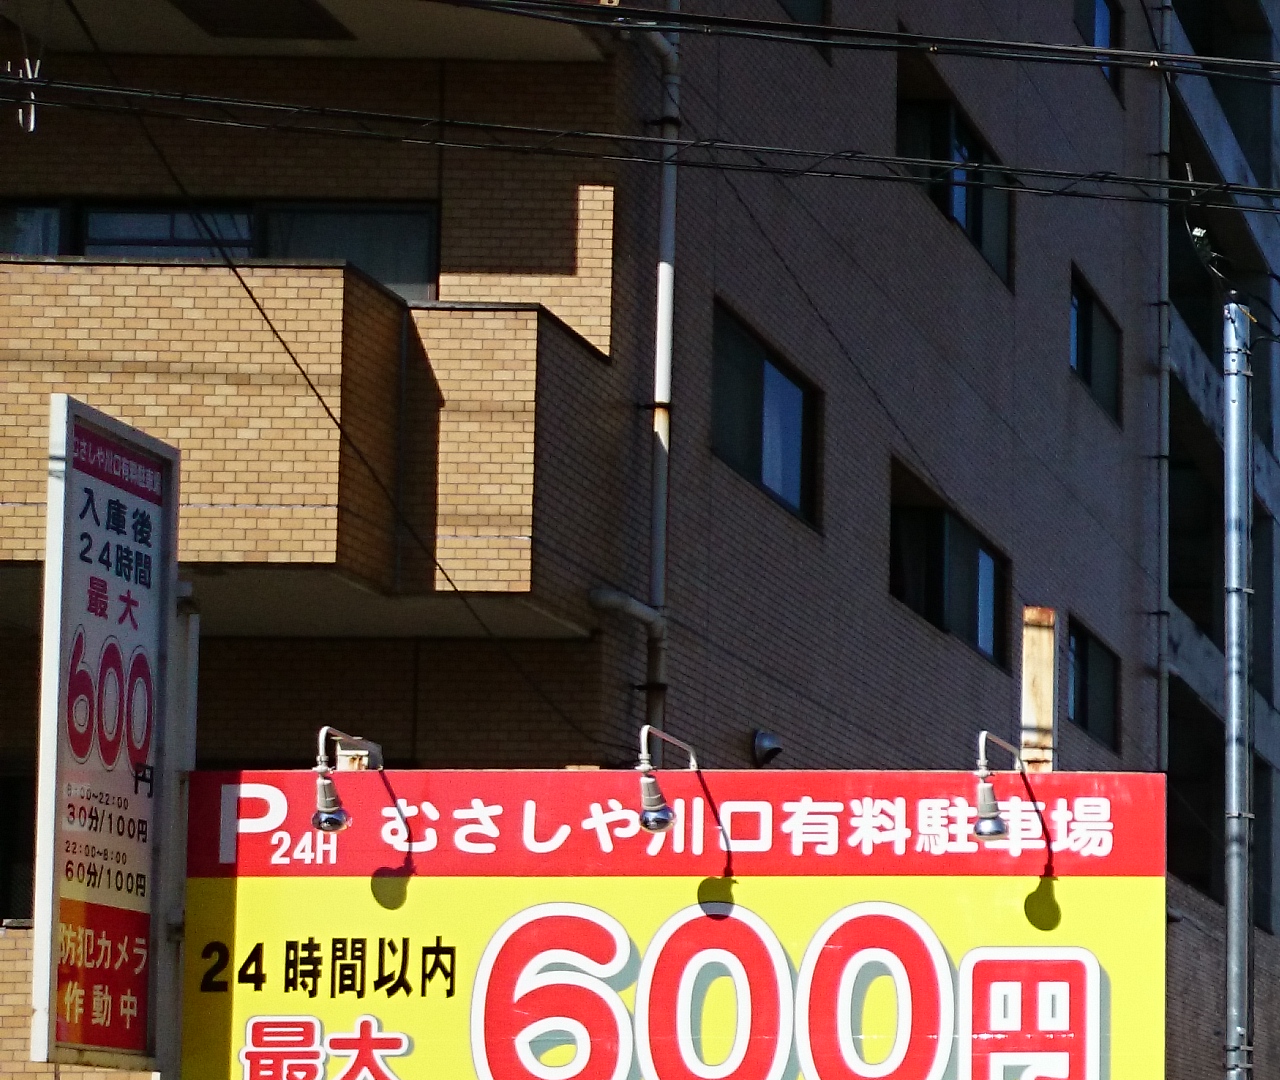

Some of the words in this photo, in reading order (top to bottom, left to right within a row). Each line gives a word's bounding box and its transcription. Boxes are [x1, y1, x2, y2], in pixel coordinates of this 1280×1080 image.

[79, 487, 153, 548] 入庫後
[79, 531, 152, 589] 24時間
[87, 576, 140, 631] 最大
[67, 803, 149, 844] 30分/100円
[217, 783, 289, 864] P
[271, 830, 339, 866] 24H
[380, 795, 1114, 856] むさしや川口有料駐車場
[65, 860, 147, 898] 60分/100円
[58, 922, 149, 976] 防犯カメラ
[200, 935, 458, 998] 24時間以内
[64, 980, 139, 1030] 作動中
